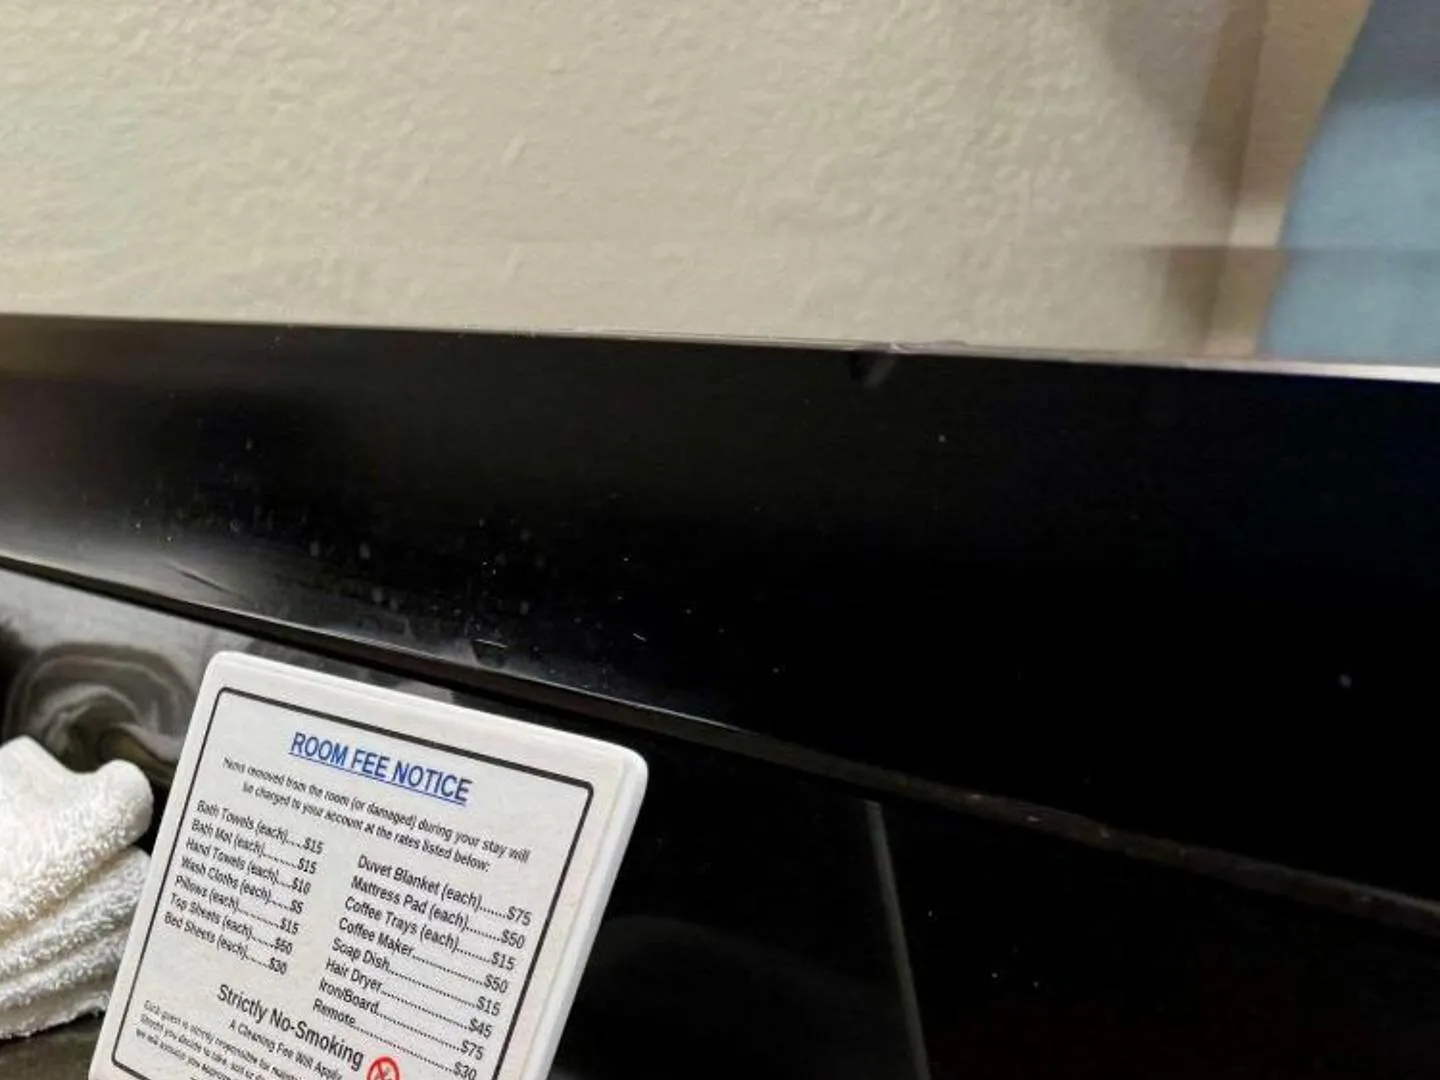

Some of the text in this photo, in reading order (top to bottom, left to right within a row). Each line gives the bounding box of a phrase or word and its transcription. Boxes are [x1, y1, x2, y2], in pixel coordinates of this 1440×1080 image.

[291, 732, 472, 802] ROOM FEE NOTICE
[192, 819, 213, 837] Bath
[197, 800, 219, 817] Bath
[222, 808, 254, 830] Towels
[247, 767, 285, 785] removed
[309, 785, 323, 798] the
[324, 791, 349, 806] room
[367, 803, 417, 830] damaged)
[418, 819, 453, 842] during
[454, 832, 480, 847] your
[482, 840, 507, 858] stay
[509, 849, 530, 863] will
[255, 787, 290, 806] charged
[292, 798, 301, 809] to
[302, 803, 324, 817] your
[324, 811, 363, 830] account
[364, 824, 375, 834] at
[376, 826, 392, 840] the
[394, 833, 420, 849] rates
[422, 840, 452, 859] listed
[182, 856, 206, 876] Wash
[208, 867, 238, 889] Cloths
[186, 838, 211, 856] Hand
[213, 847, 246, 870] Towels
[358, 854, 392, 877] Duvet
[393, 867, 440, 895] Blanket
[505, 906, 531, 926] $75
[164, 912, 183, 928] Bed
[184, 920, 215, 943] Sheets
[345, 896, 382, 920] Coffee
[386, 911, 417, 935] Trays
[489, 952, 515, 971] $15
[351, 876, 400, 904] Mattress
[403, 894, 428, 914] Pad
[499, 929, 525, 949] $50
[332, 937, 501, 1016] Soap Dish $15
[339, 917, 508, 993] Coffee Maker $50
[217, 984, 364, 1071] Strictly No-Smoking
[313, 998, 355, 1028] Remote
[319, 977, 484, 1060] Iron/Board $75
[325, 958, 492, 1039] Hair Dryer $45
[229, 1020, 235, 1030] A
[238, 1023, 275, 1052] Cleaning
[276, 1042, 294, 1059] Fee
